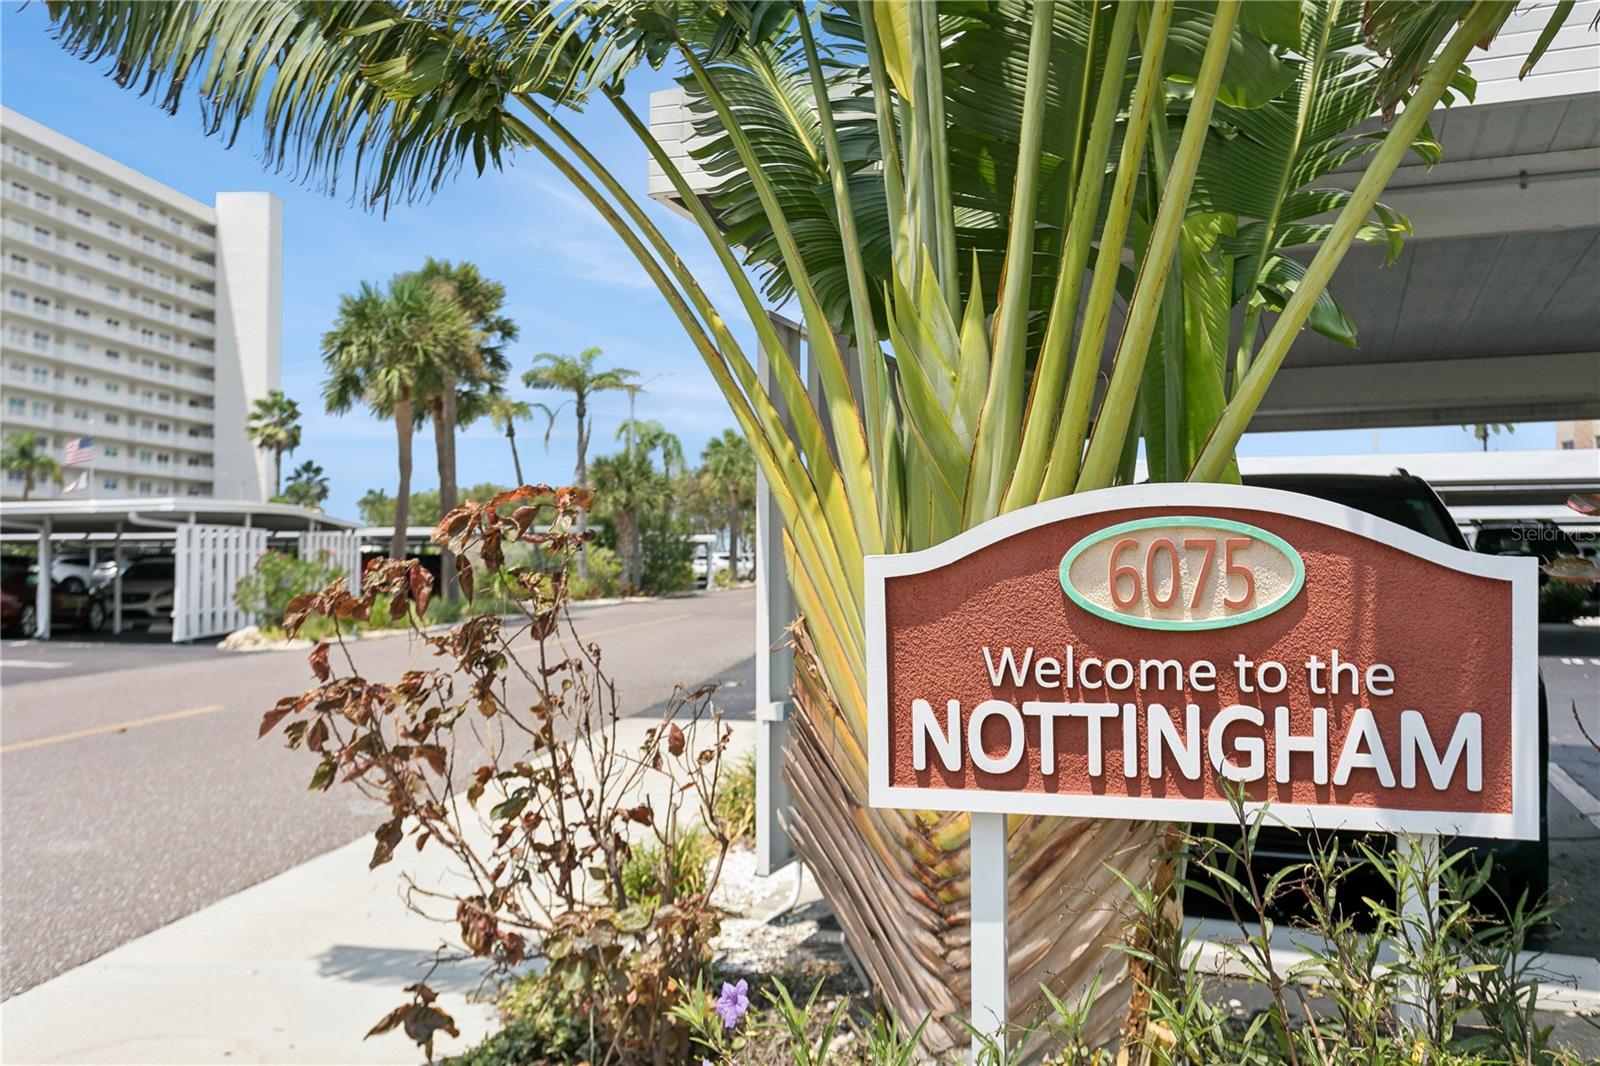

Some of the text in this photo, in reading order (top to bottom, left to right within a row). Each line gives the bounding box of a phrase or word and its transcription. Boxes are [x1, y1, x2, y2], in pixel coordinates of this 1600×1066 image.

[1109, 538, 1255, 609] 6075
[982, 645, 1395, 696] Welcome to the
[911, 699, 1483, 792] NOTTINGHAM
